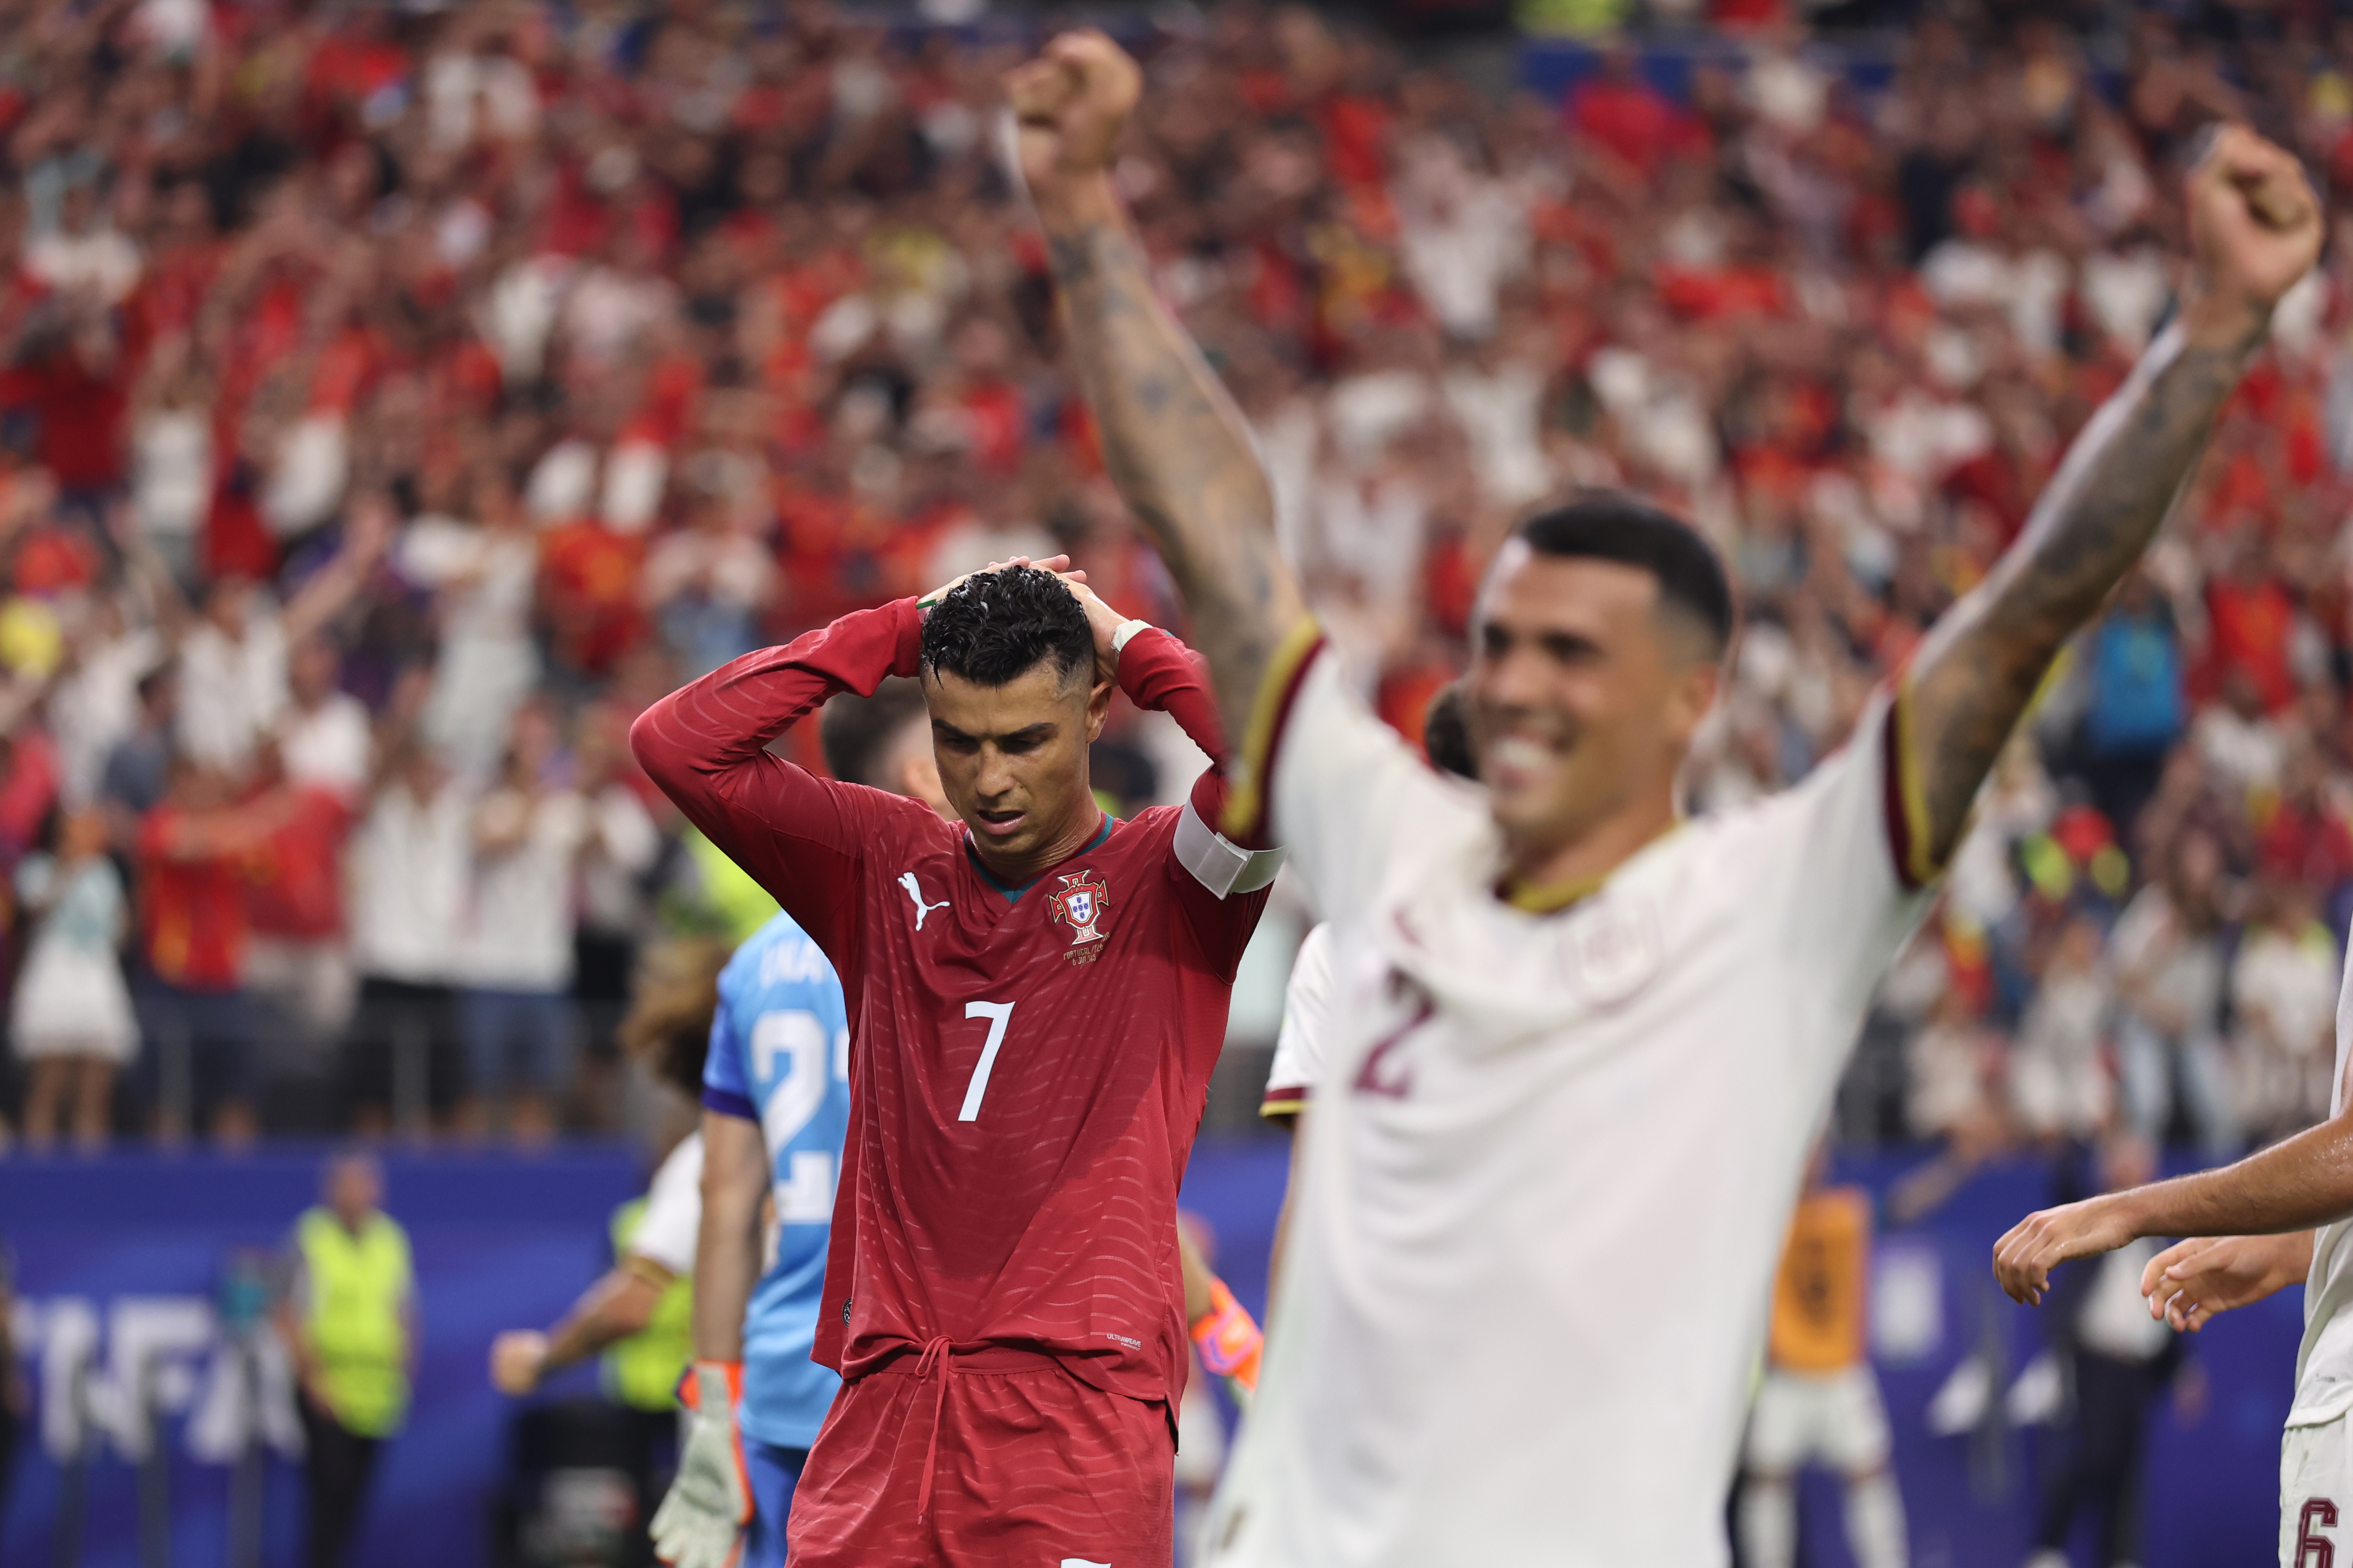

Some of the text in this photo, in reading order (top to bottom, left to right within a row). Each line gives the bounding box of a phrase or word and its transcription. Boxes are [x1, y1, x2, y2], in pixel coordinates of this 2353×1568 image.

[957, 1001, 1016, 1122] 7
[750, 1009, 849, 1225] 2
[1107, 1333, 1142, 1347] ULTRAWEAVE
[2294, 1497, 2339, 1568] 6
